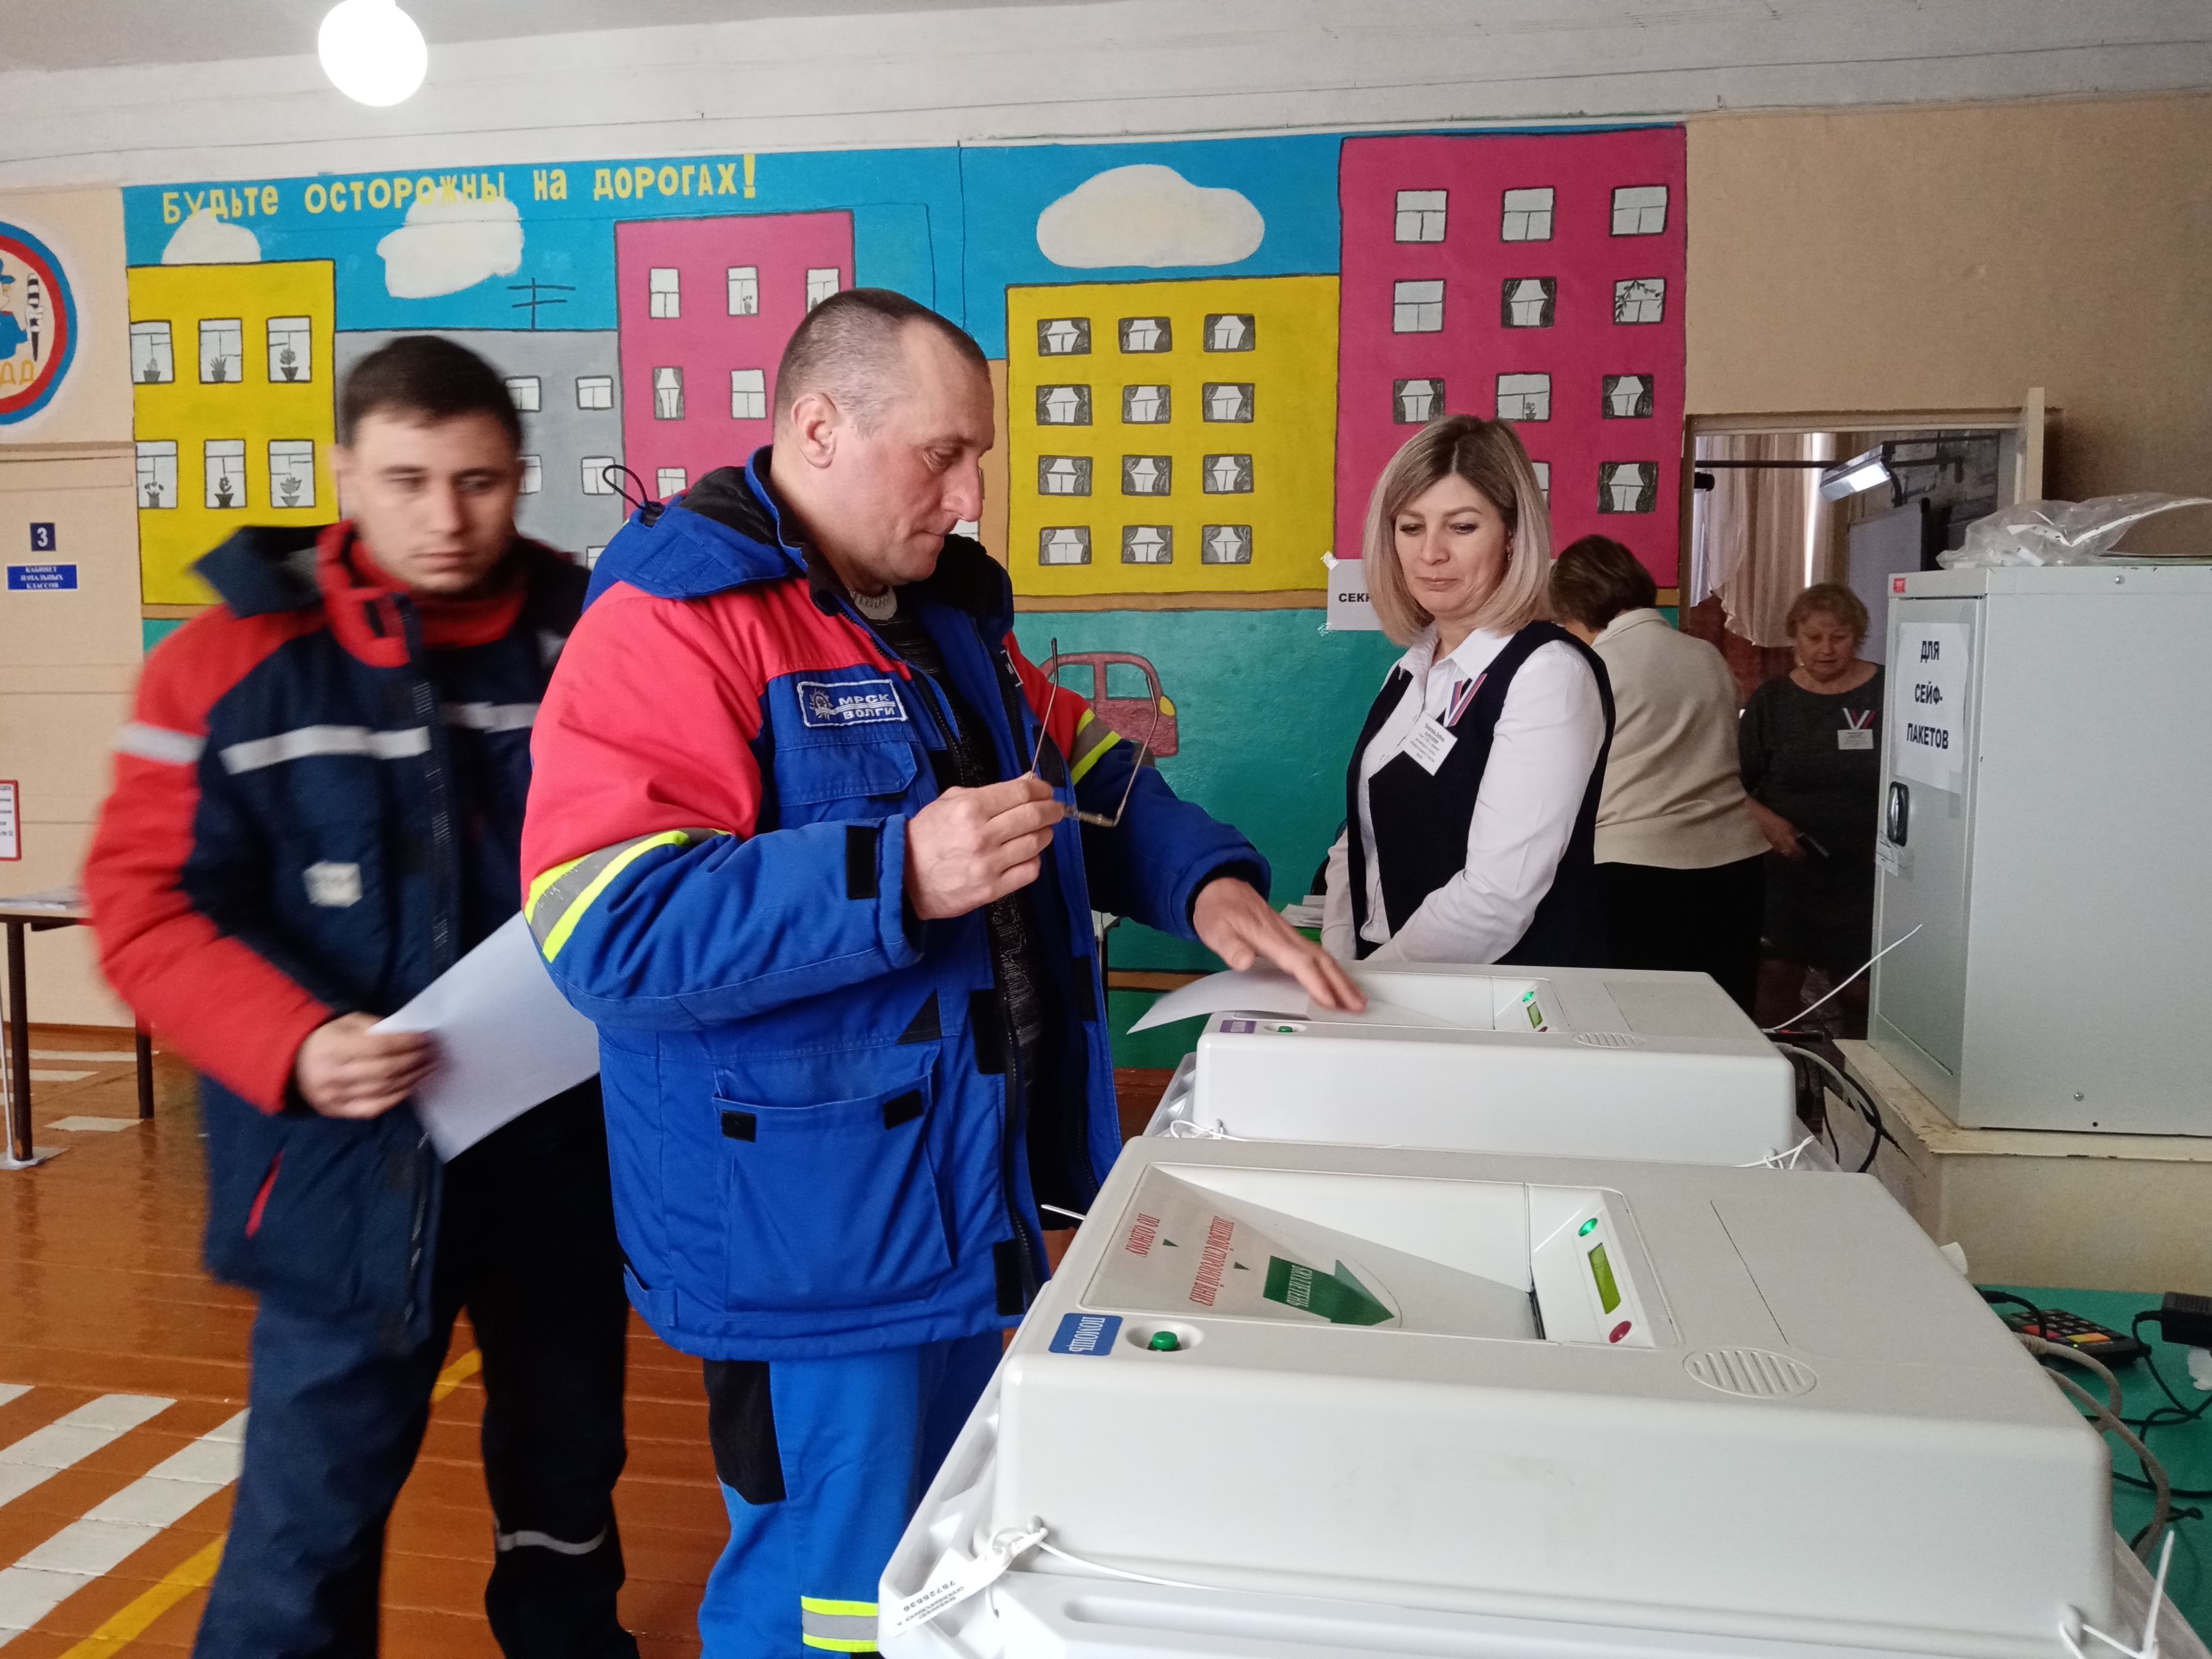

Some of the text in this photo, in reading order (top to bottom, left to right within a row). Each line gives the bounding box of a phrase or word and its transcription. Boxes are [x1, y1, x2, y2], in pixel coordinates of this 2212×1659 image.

[304, 171, 505, 213] ОСТОРОЖНЫ
[593, 154, 756, 201] ДОРОГАХ!
[37, 527, 48, 547] 3
[1920, 641, 1940, 664] ДЛЯ
[838, 693, 890, 706] МРСК
[1914, 681, 1943, 705] СЕЙФ-
[842, 707, 896, 720] ВОЛГИ
[1906, 723, 1949, 749] ПАКЕТОВ
[1065, 1317, 1106, 1352] ПОМОЩЬ
